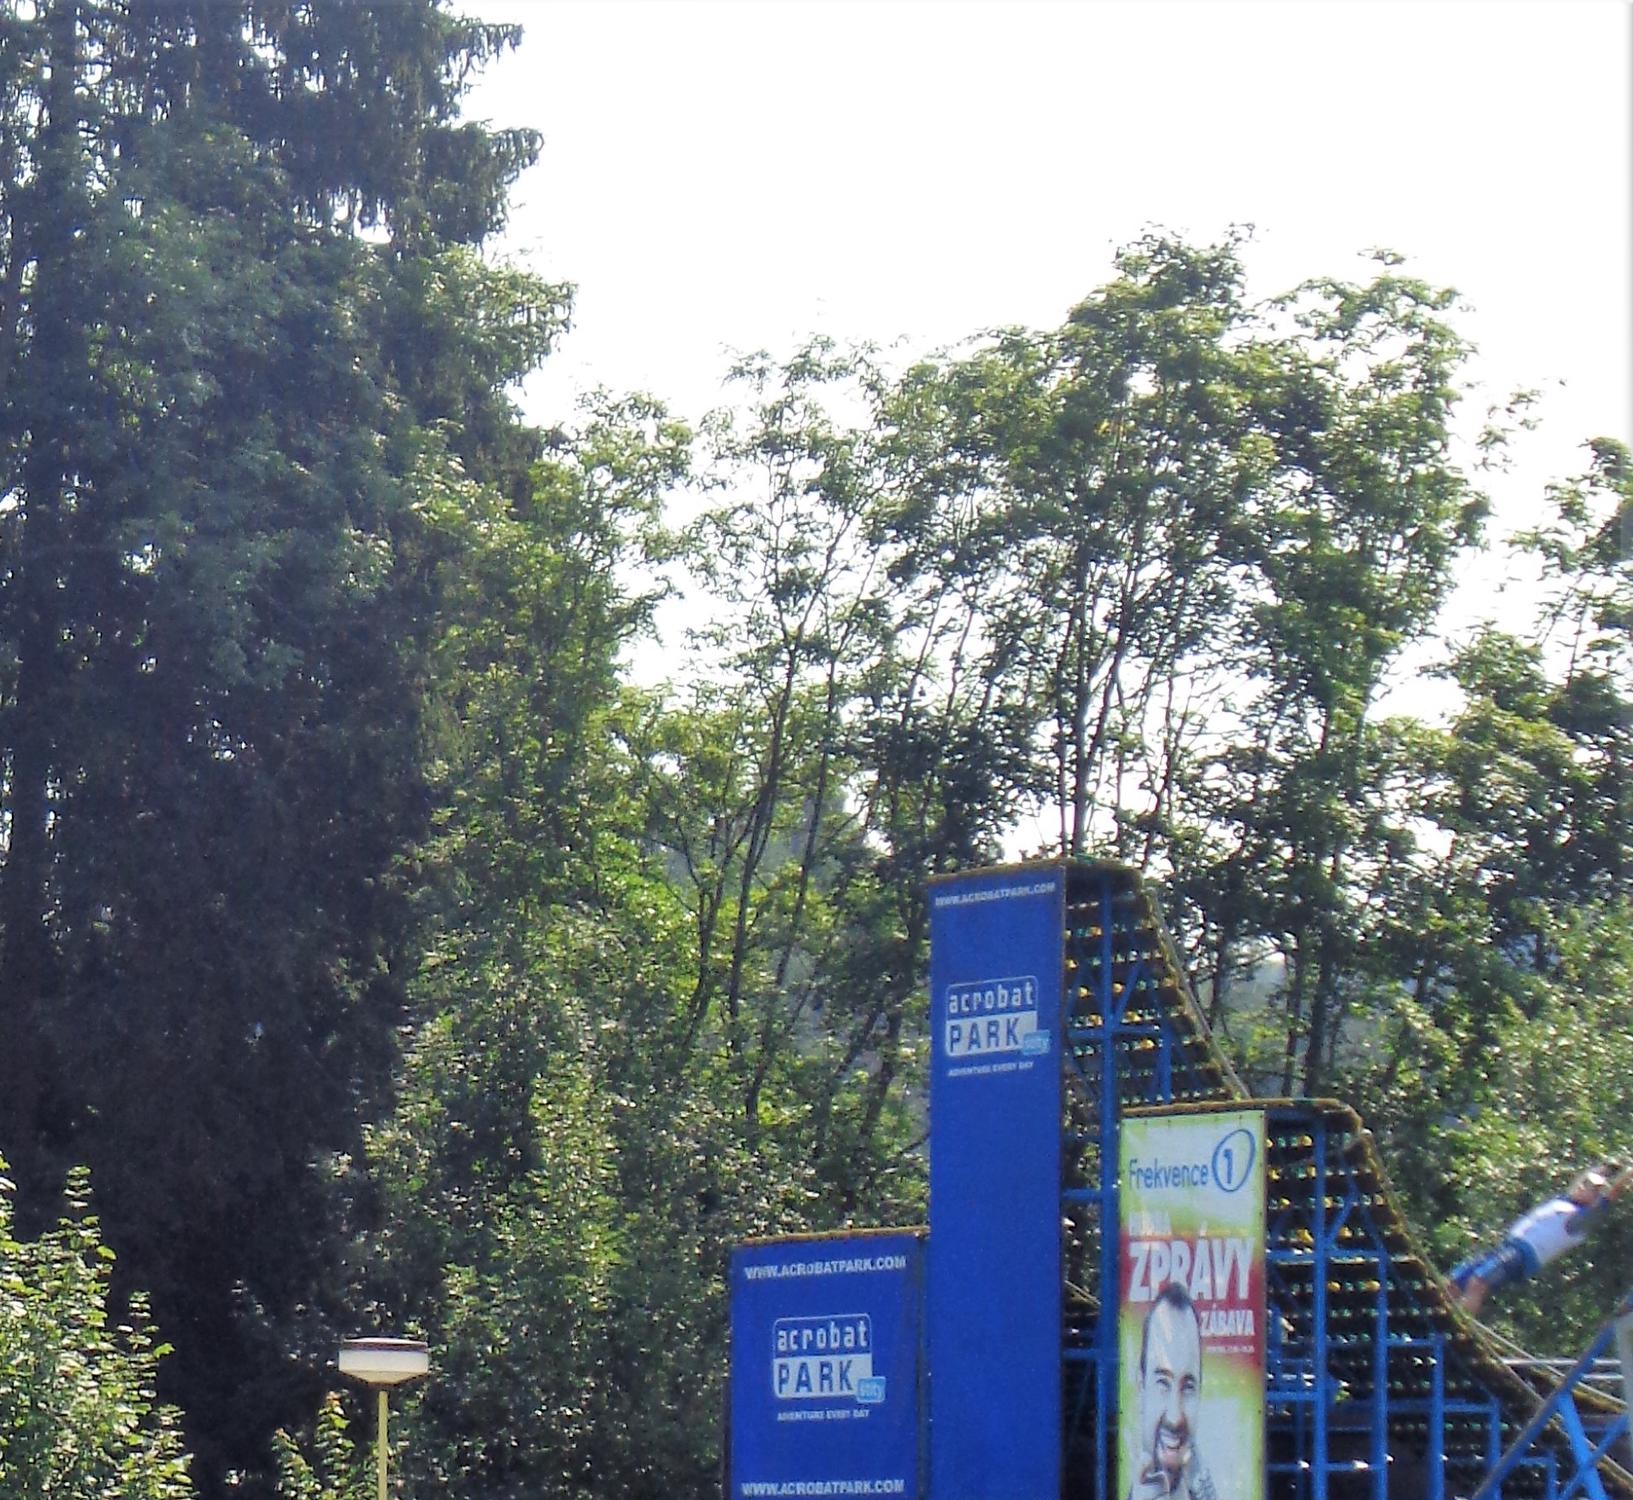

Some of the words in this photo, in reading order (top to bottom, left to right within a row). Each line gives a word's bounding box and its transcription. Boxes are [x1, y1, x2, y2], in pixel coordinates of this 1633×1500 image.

[949, 982, 1033, 1014] acrobat
[949, 1017, 1020, 1053] PARK
[1128, 1157, 1209, 1190] Frekvence
[1223, 1148, 1234, 1185] 1
[744, 1256, 907, 1280] WWW.ACROBATPARK.COM
[1128, 1219, 1256, 1302] ZPRÁVY
[777, 1320, 868, 1351] acrobat
[1200, 1303, 1256, 1336] ZÁBAVA
[777, 1359, 855, 1394] PARK
[741, 1479, 905, 1496] WWW.ACROBATPARK.COM
